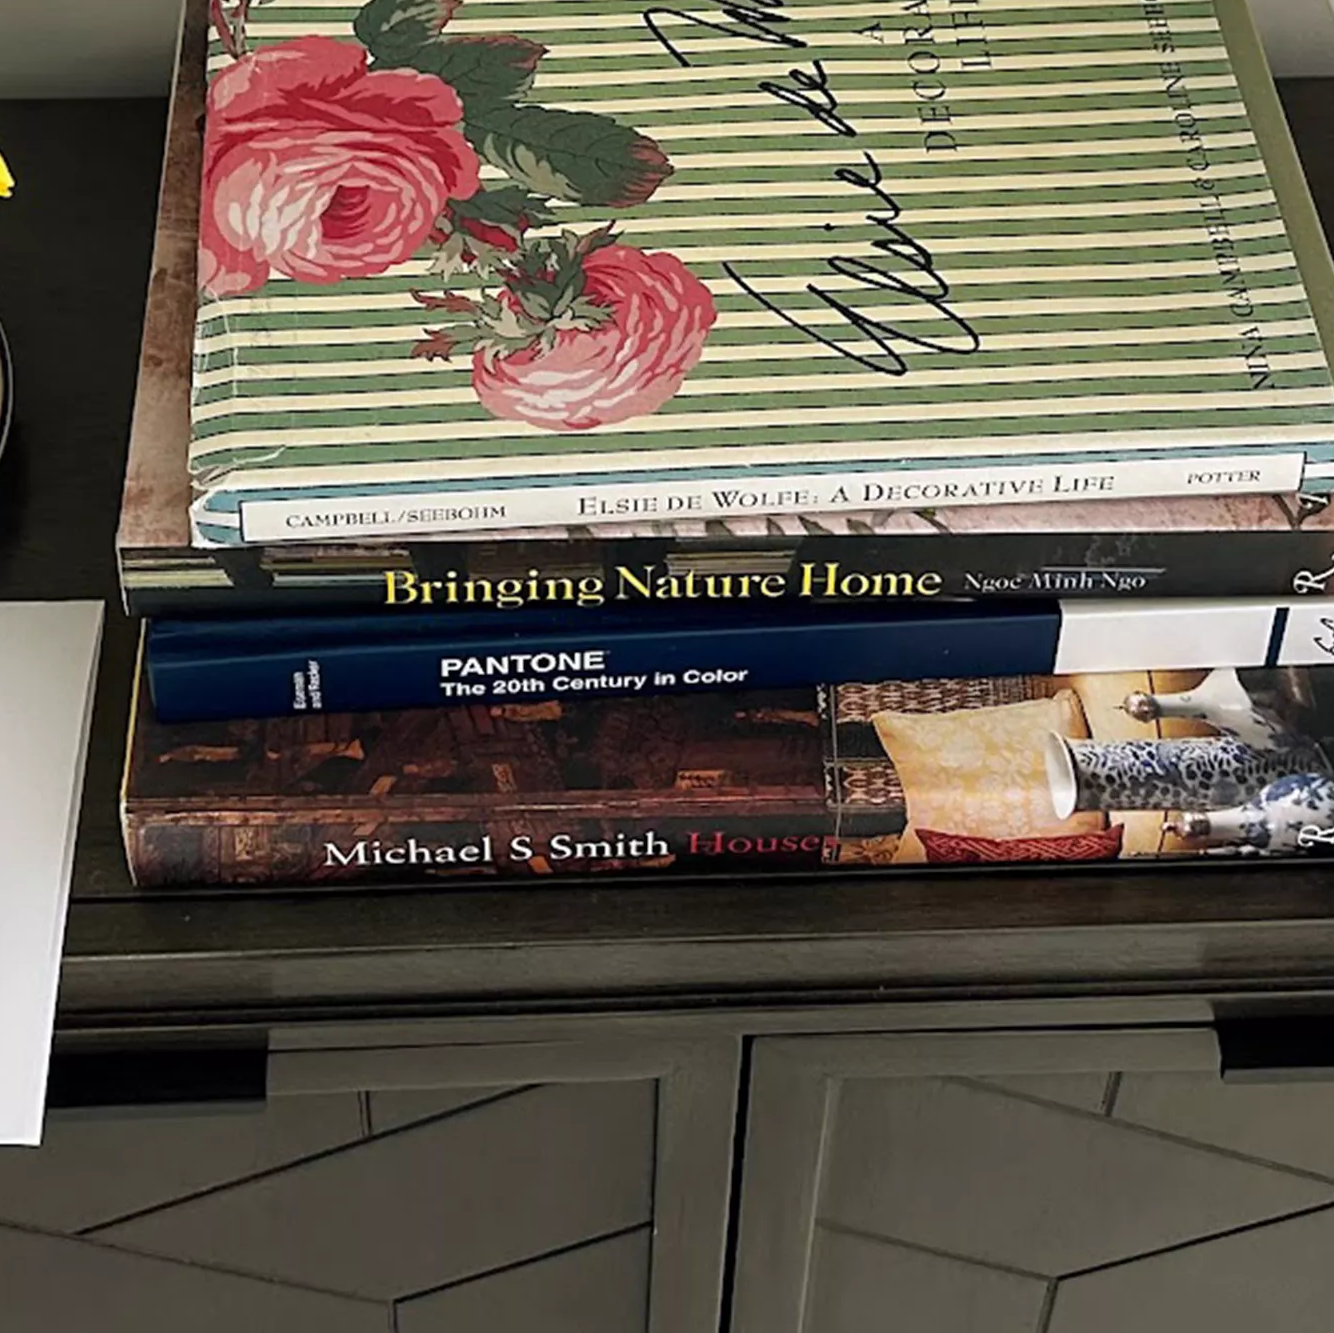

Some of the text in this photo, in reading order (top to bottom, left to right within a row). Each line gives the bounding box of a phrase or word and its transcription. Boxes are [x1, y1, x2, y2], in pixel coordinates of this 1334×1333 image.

[852, 20, 885, 45] A
[1160, 61, 1211, 171] CAROLINE
[1199, 194, 1254, 318] CAMPBELL
[1239, 325, 1276, 390] NINA
[1185, 469, 1262, 485] POTTER
[578, 496, 657, 516] ELSIE
[667, 495, 702, 511] DE
[830, 485, 850, 503] A
[863, 478, 1043, 501] DECORATIVE
[1051, 474, 1115, 493] LIFE
[285, 504, 507, 529] CAMPBELL/SEEBOHM
[384, 561, 943, 609] Bringing Nature Home
[963, 571, 1147, 594] Ngoc Minh Ngo
[439, 650, 606, 678] PANTONE
[439, 668, 750, 697] The 20th Century in Color
[322, 830, 669, 867] Michael S Smith
